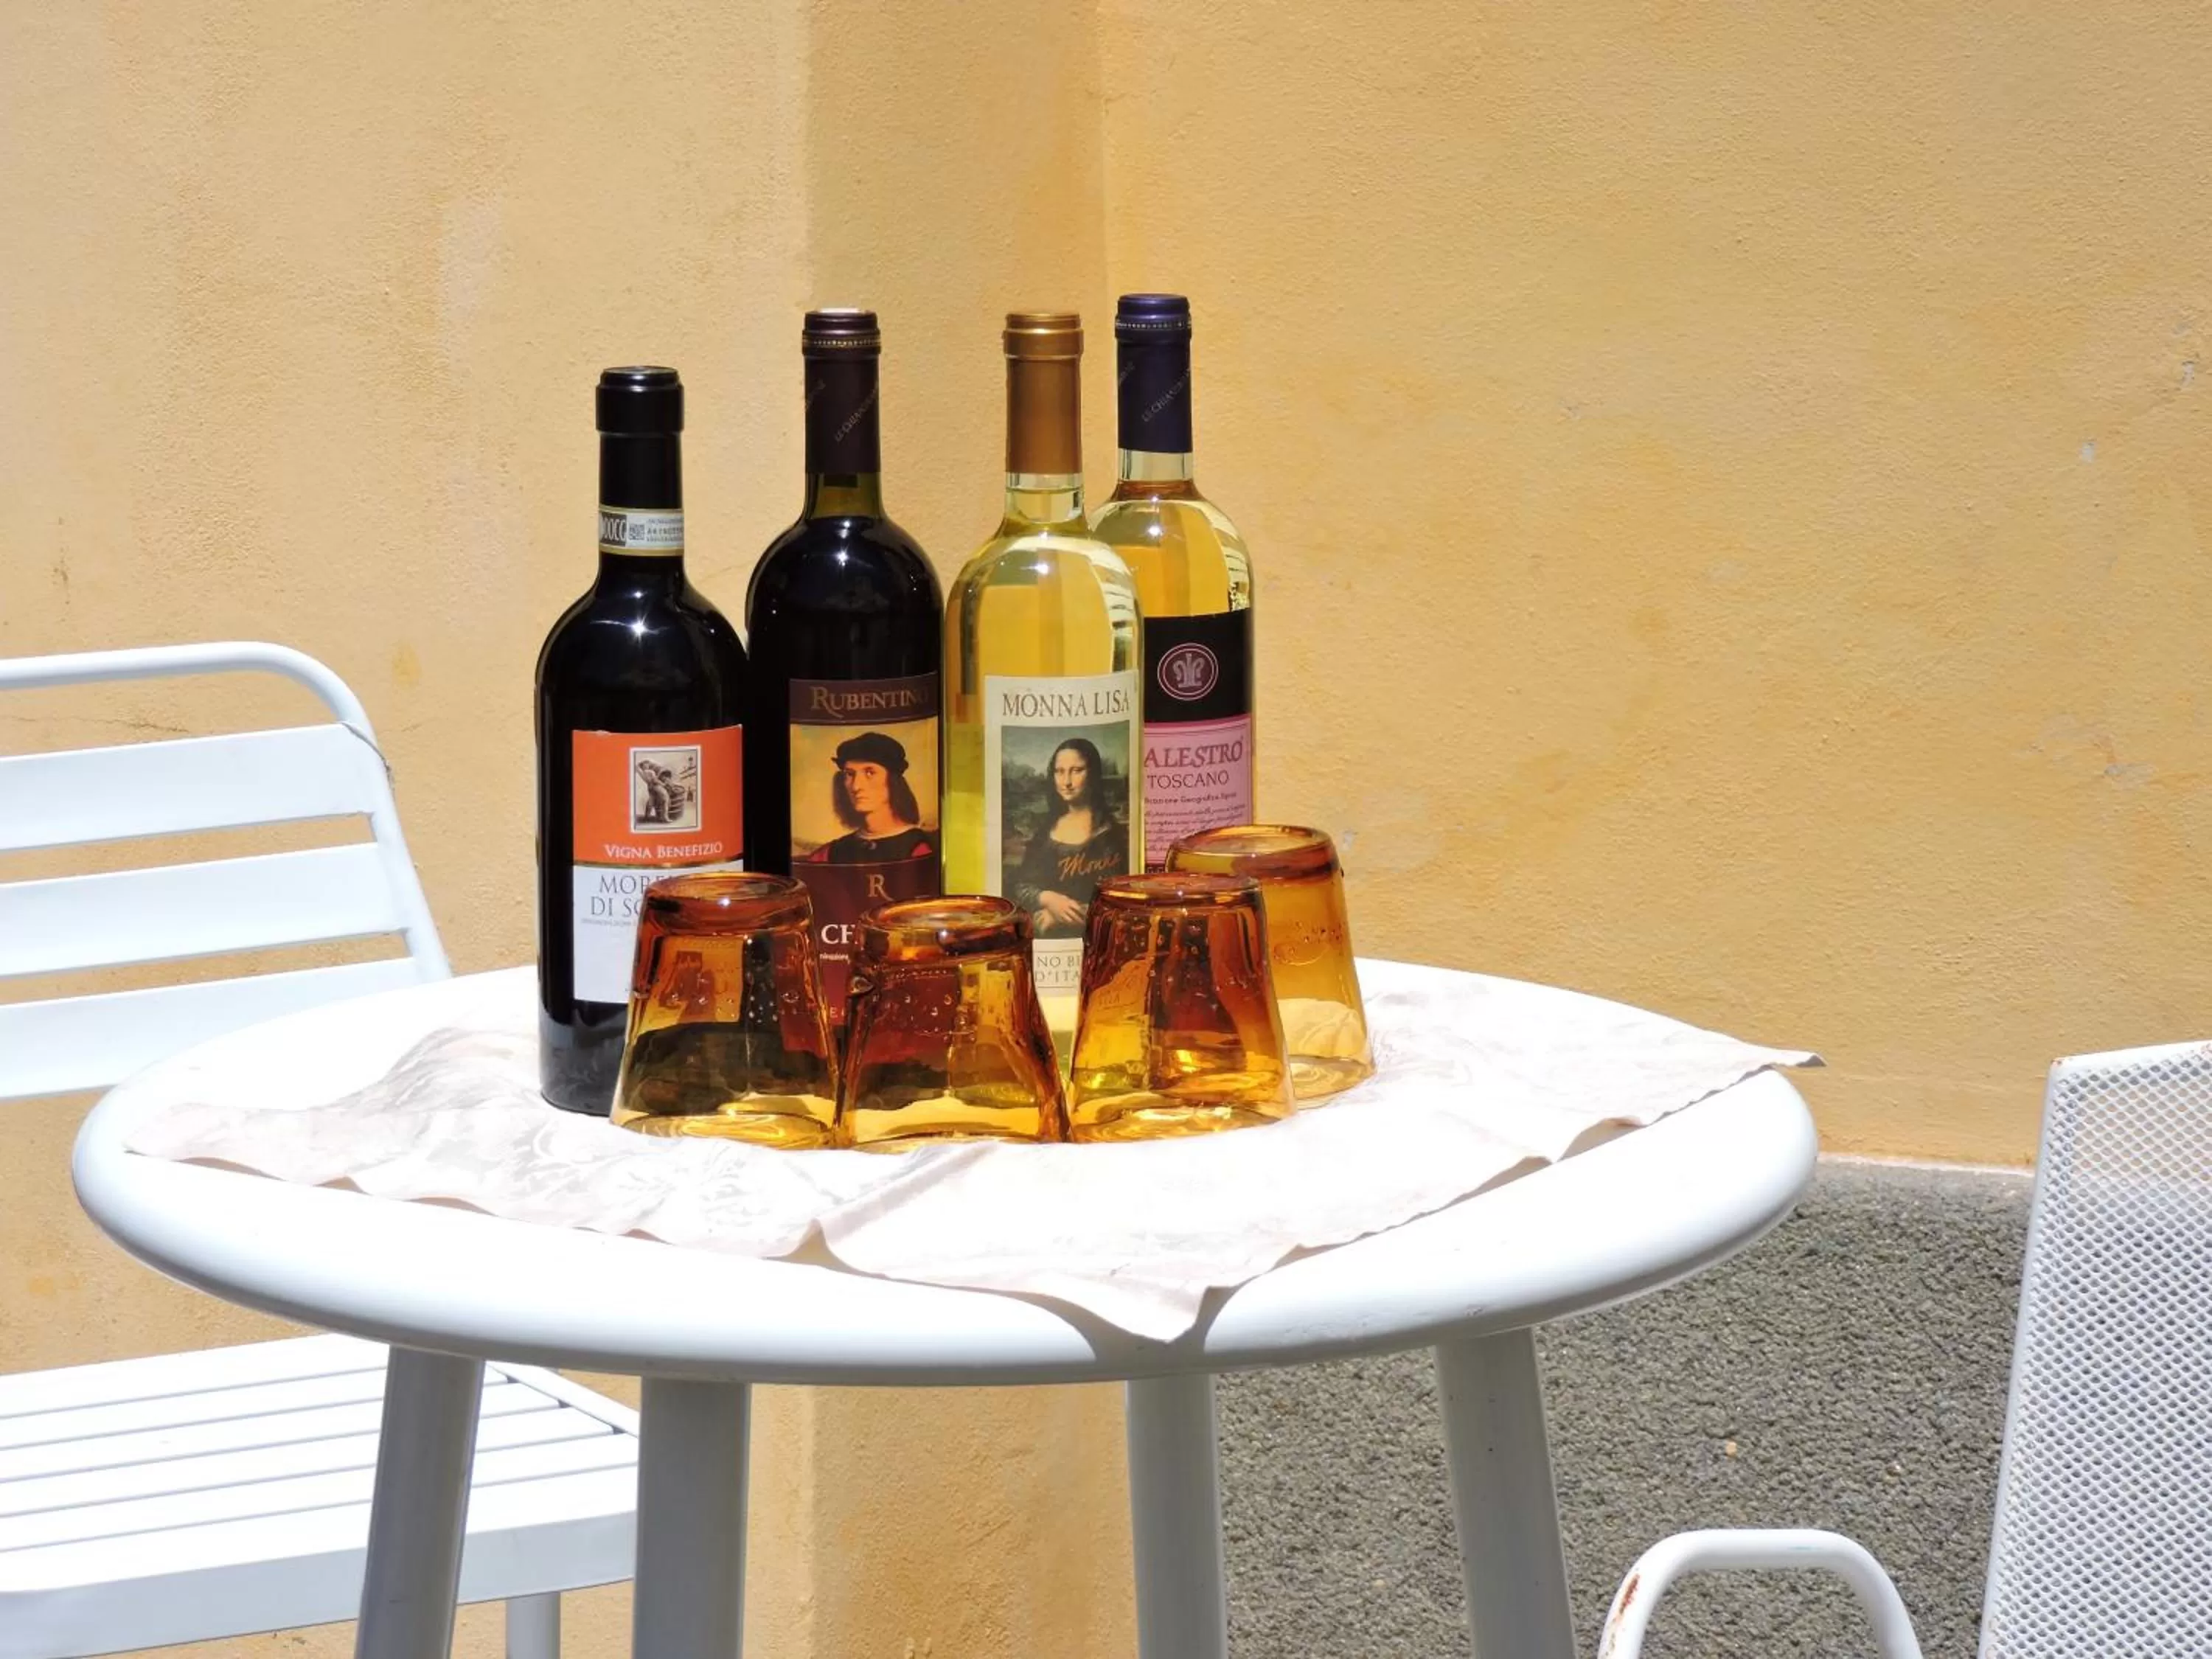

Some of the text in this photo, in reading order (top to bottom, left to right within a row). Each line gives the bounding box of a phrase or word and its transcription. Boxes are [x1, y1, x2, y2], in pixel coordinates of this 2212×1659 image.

[1002, 689, 1130, 717] MONNA LISA
[1144, 740, 1243, 768] ALESTRO
[1147, 770, 1229, 789] TOSCANO
[604, 842, 723, 859] VIGNA BENEFIZIO
[866, 874, 894, 901] R
[591, 897, 613, 917] DI
